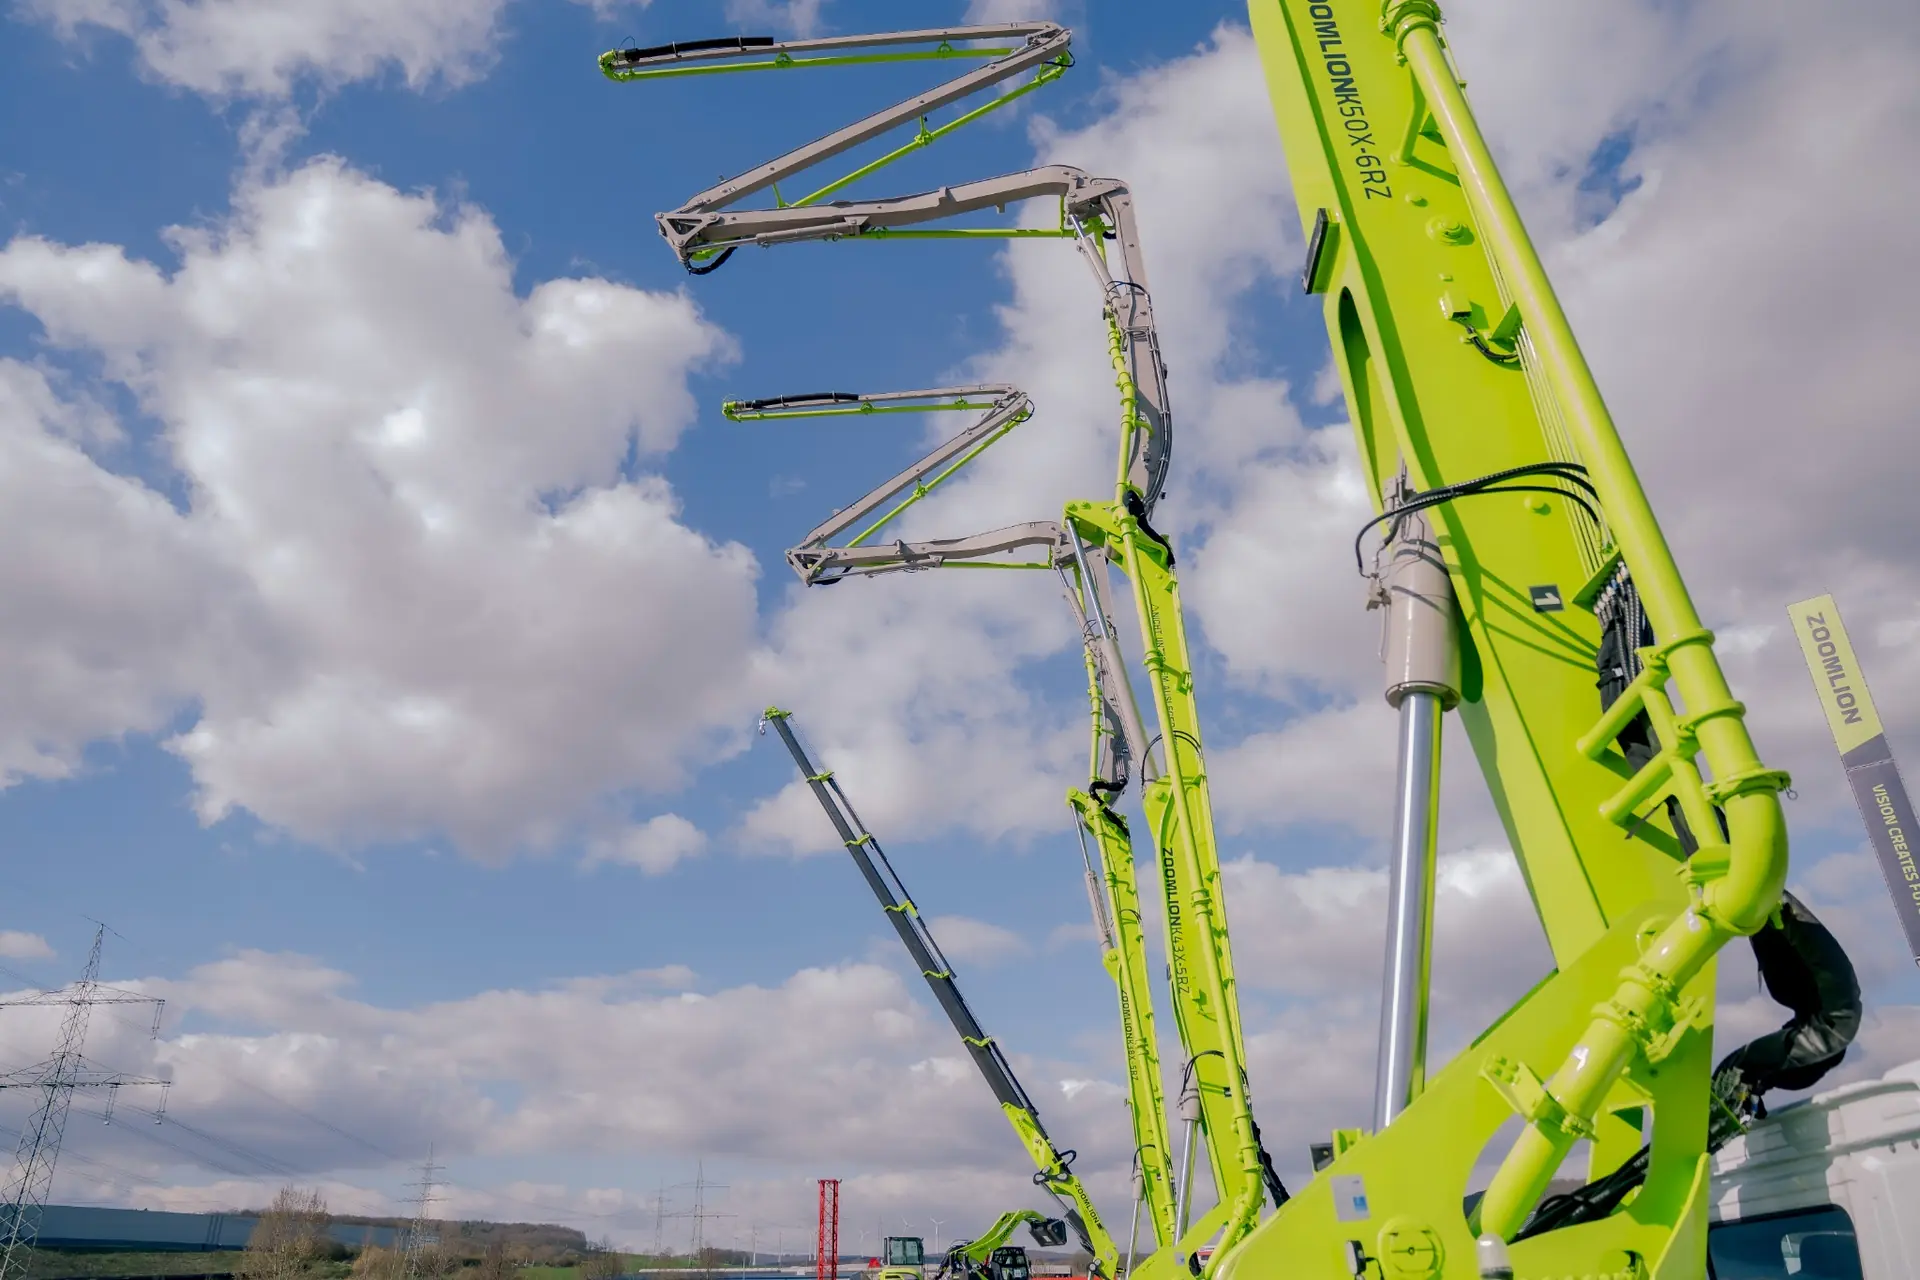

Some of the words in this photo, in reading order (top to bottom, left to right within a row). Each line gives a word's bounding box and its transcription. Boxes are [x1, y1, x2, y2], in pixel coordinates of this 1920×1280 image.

[1806, 611, 1863, 726] ZOOMLION
[1872, 783, 1899, 826] VISION
[1888, 827, 1920, 882] CREATES
[1075, 1182, 1100, 1224] ZOOMLION
